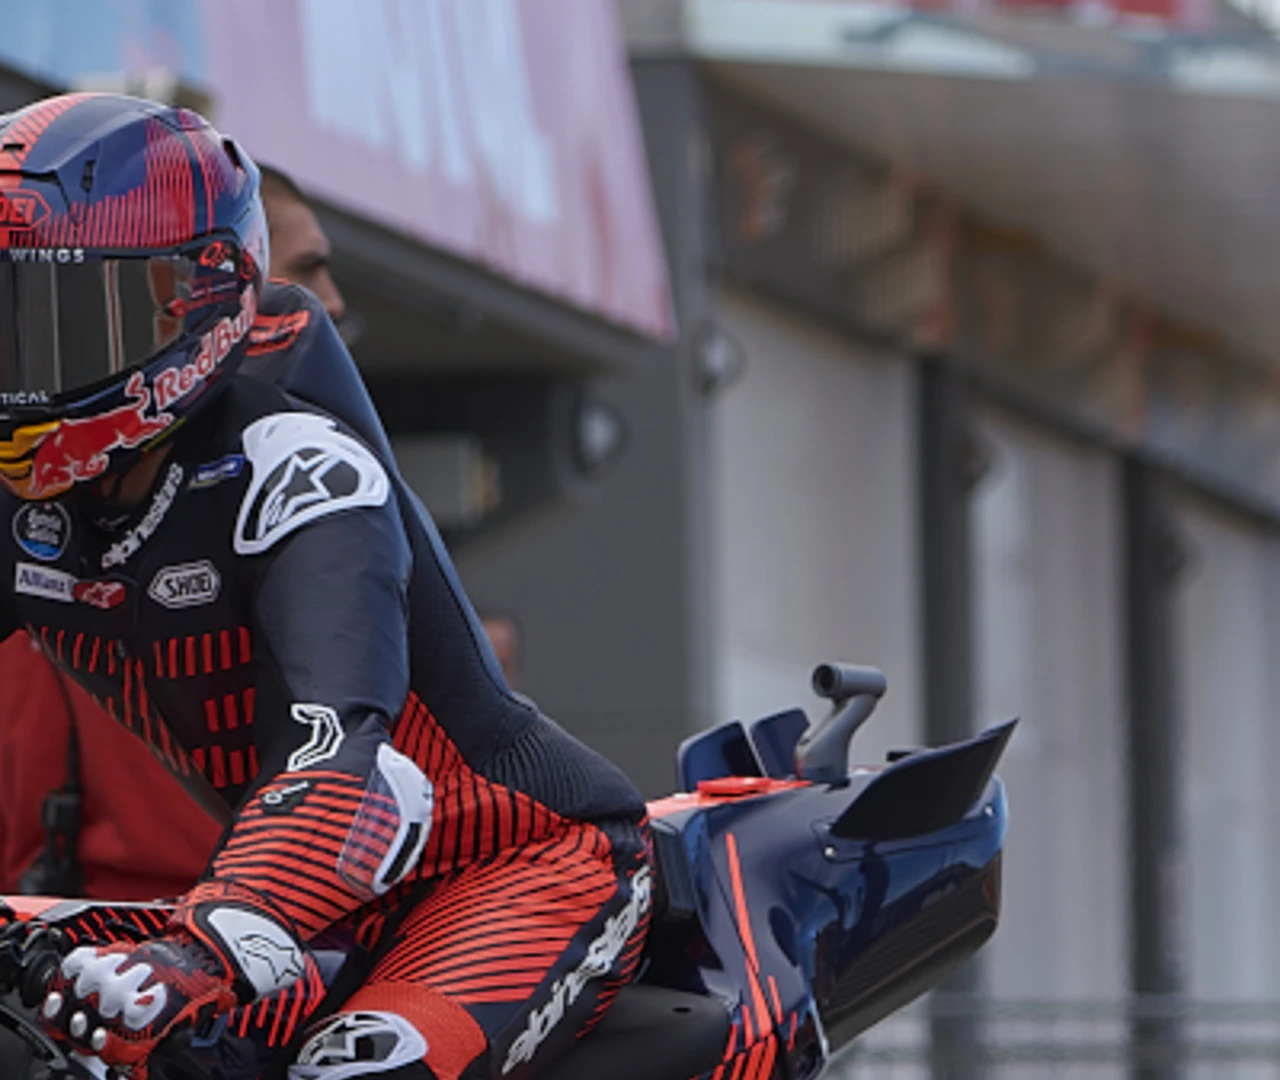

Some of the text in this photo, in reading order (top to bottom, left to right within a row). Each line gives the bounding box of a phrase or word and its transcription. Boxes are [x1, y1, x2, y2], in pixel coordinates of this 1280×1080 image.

[9, 247, 85, 263] WINGS
[153, 332, 216, 411] Red
[164, 573, 212, 598] SHOEI
